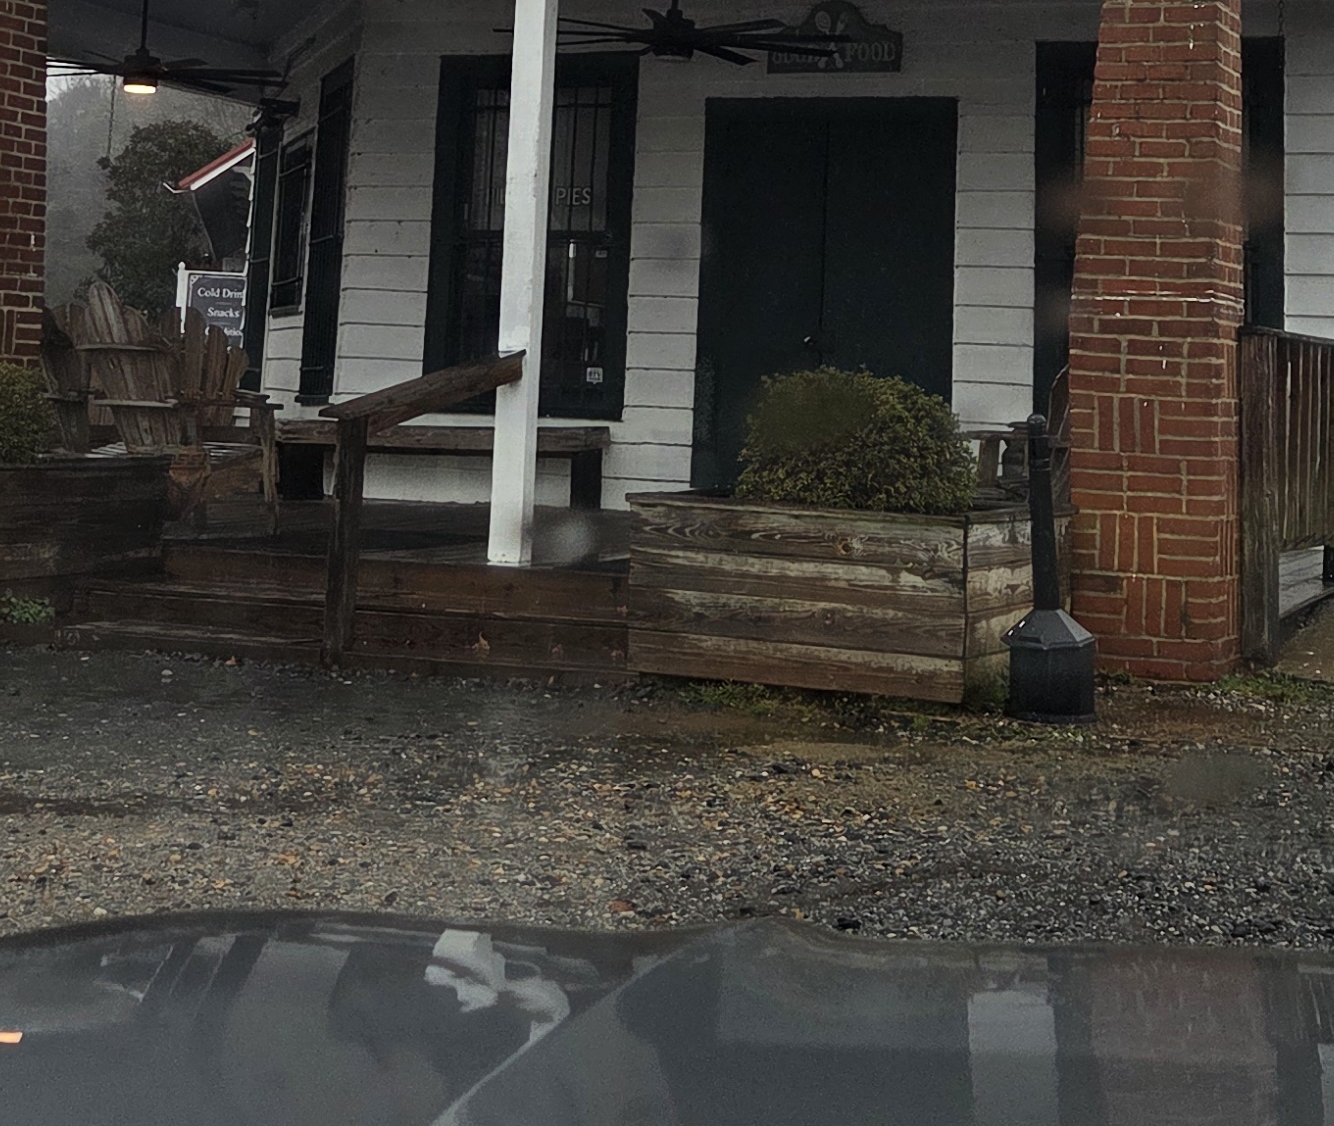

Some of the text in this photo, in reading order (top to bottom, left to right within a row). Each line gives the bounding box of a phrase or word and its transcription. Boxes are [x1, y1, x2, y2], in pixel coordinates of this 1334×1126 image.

[843, 42, 896, 62] FOOD
[555, 187, 592, 205] PIES
[197, 287, 219, 298] Cold
[207, 306, 240, 318] Snacks
